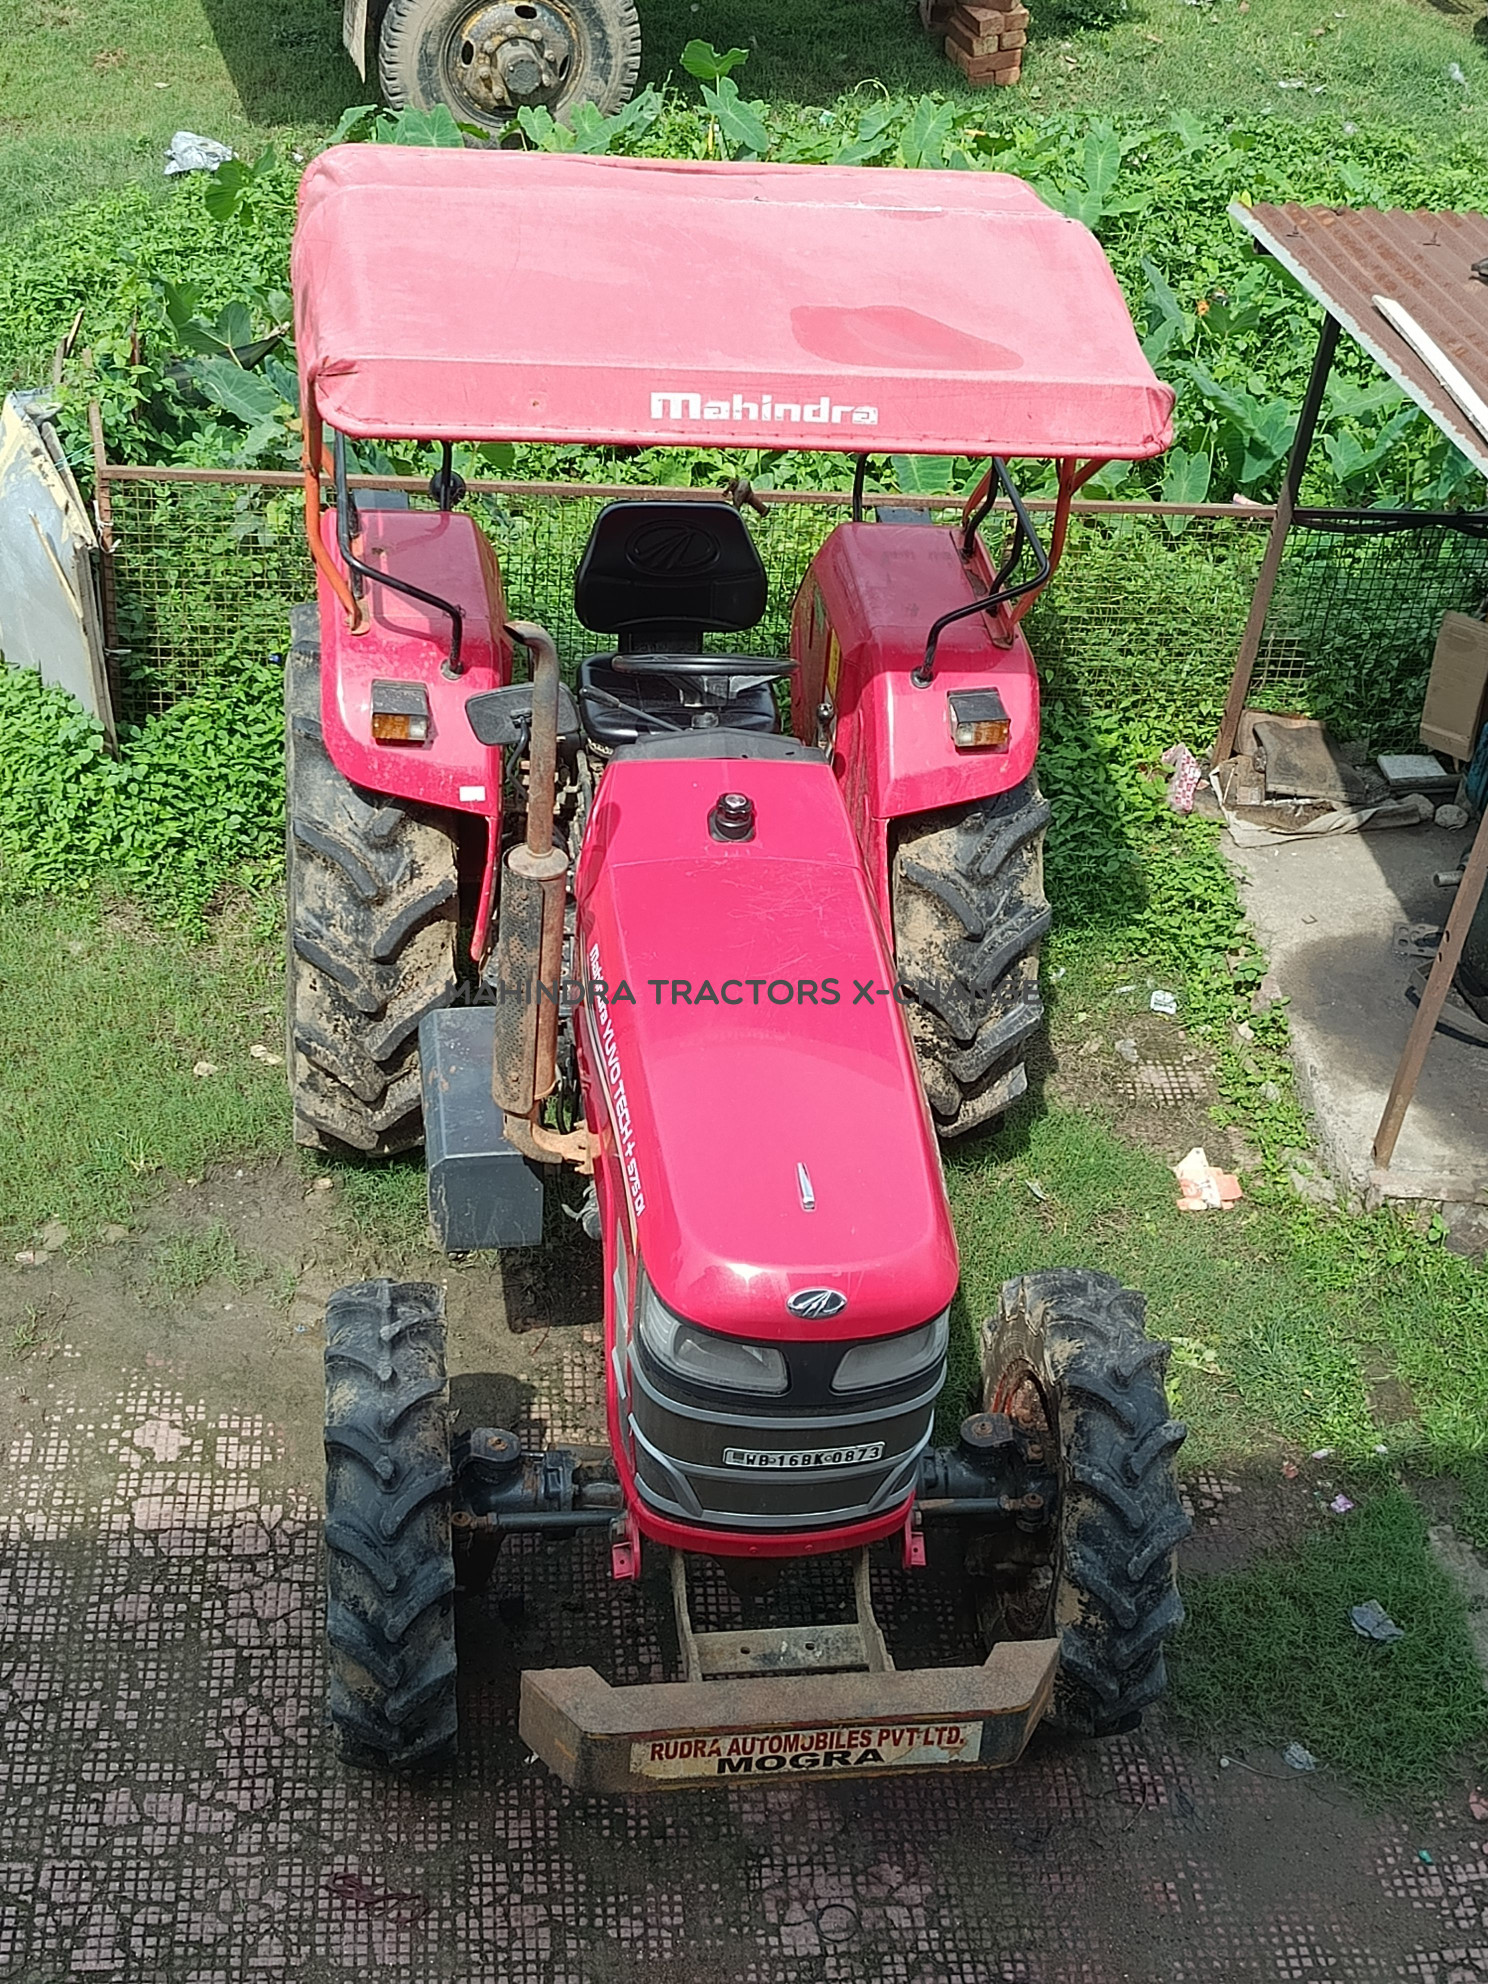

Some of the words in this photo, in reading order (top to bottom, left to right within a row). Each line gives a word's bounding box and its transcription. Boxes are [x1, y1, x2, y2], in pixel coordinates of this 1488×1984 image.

[650, 391, 879, 425] Mahindra
[602, 1018, 621, 1085] YUVO
[613, 1079, 632, 1145] TECH
[650, 1738, 722, 1761] RUDRA
[726, 1729, 872, 1758] AUTOMOBILES
[877, 1728, 920, 1747] PVT
[717, 1748, 885, 1774] MOGRA
